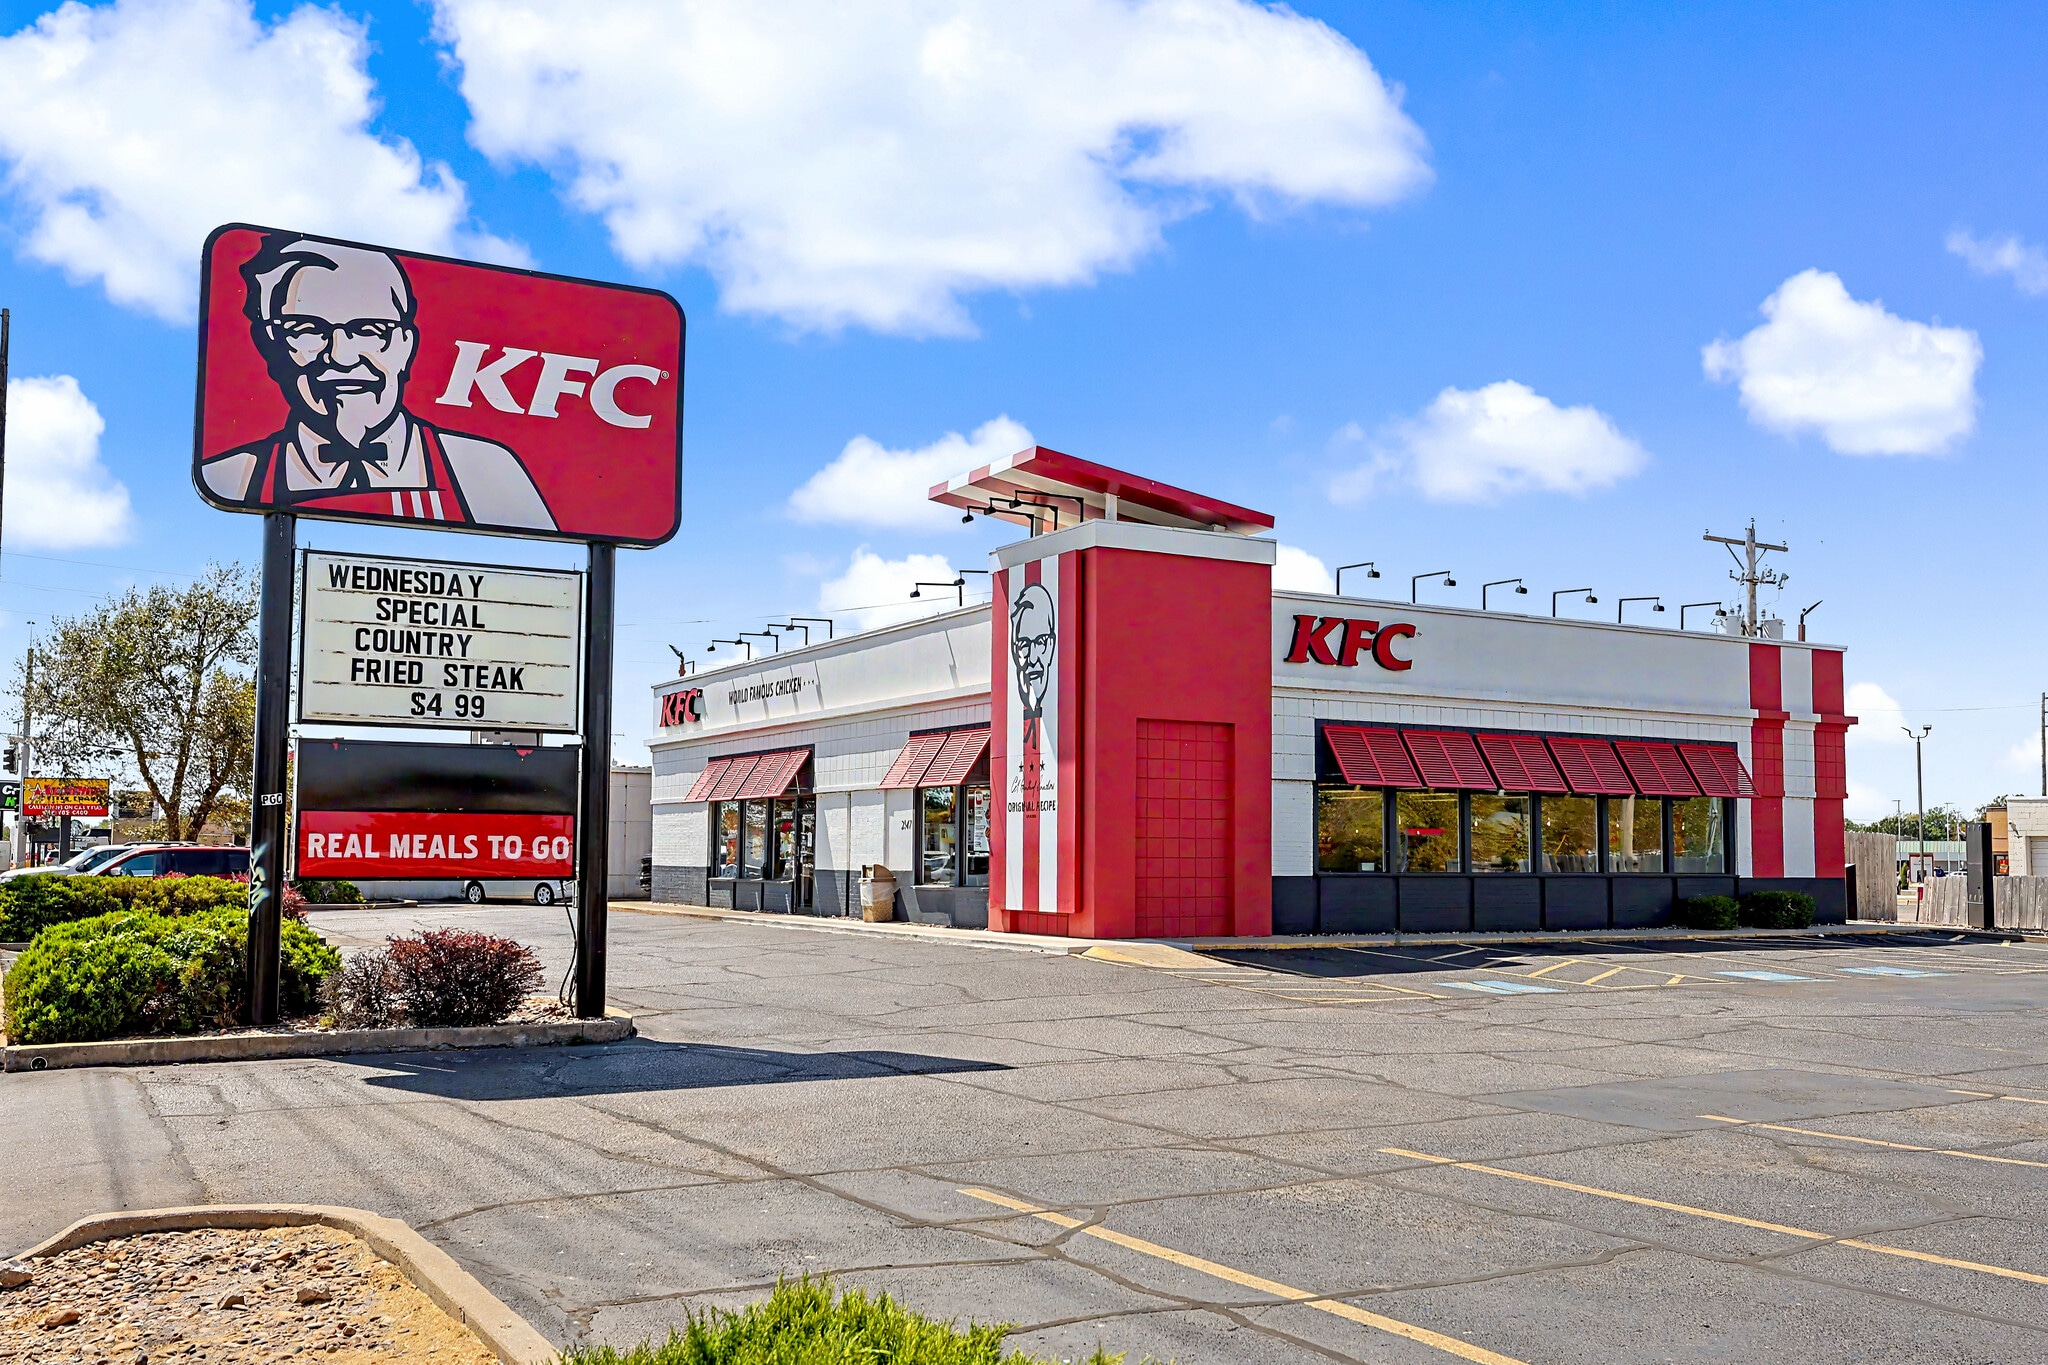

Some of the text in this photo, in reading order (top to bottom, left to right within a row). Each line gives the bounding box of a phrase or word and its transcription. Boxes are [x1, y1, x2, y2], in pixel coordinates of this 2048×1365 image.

[435, 340, 662, 429] KFC
[328, 563, 484, 598] WEDNESDAY
[376, 597, 486, 629] SPECIAL
[355, 627, 473, 658] COUNTRY
[1283, 614, 1417, 671] KFC
[351, 657, 524, 691] FRIED STEAK
[728, 676, 802, 705] WORLD FAMOUS CHICKEN
[659, 687, 701, 727] KFC
[1036, 800, 1056, 812] RECIPE
[307, 833, 570, 860] REAL MEALS TO GO
